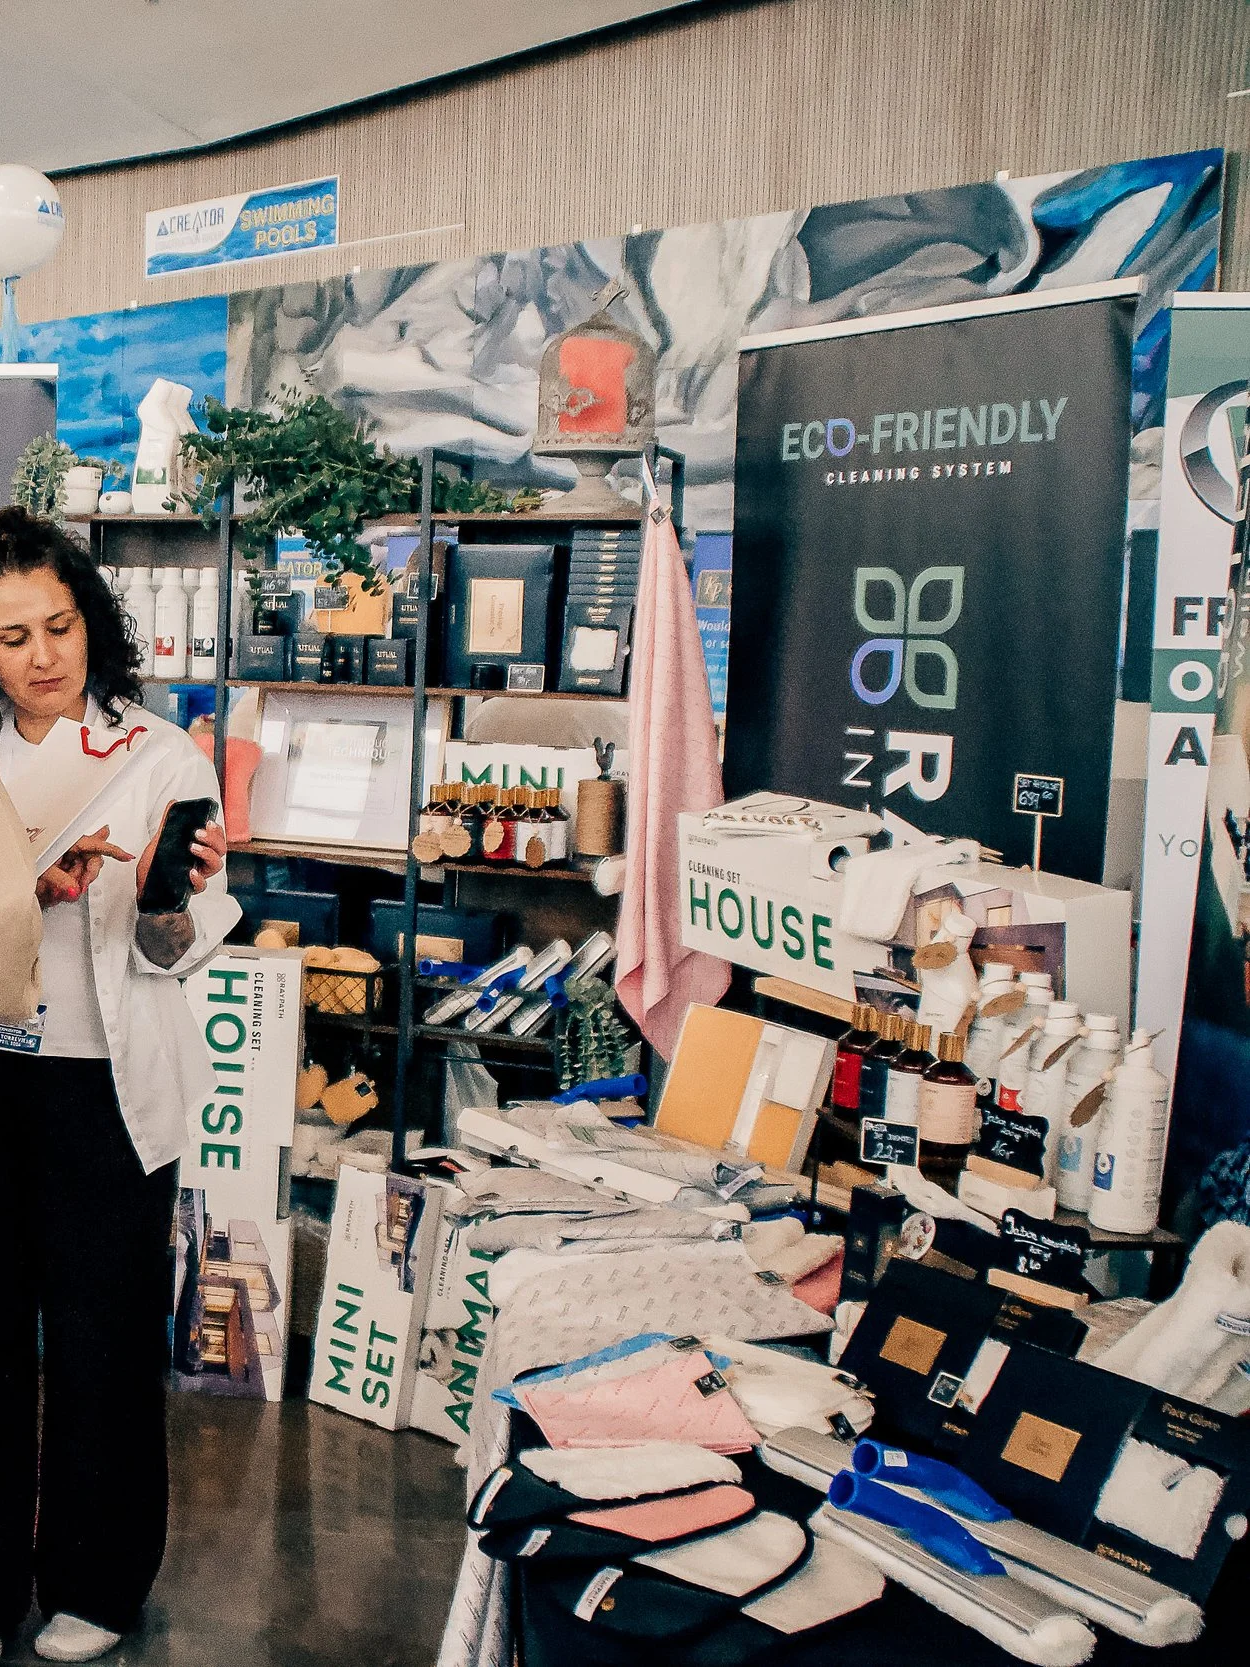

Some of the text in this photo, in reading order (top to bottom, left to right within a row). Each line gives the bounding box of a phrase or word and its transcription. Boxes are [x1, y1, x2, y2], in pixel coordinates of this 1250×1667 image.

[240, 194, 335, 231] SWIMMING
[255, 221, 317, 250] POOLS
[781, 396, 1069, 461] ECO-FRIENDLY
[825, 460, 1013, 486] CLEANING SYSTEM
[461, 762, 565, 790] MINI
[688, 860, 741, 885] CLEANING SET
[688, 877, 835, 971] HOUSE
[251, 972, 265, 1052] CLEANING SET
[278, 983, 287, 1019] RAYPATH
[437, 1255, 449, 1298] CLEANING
[325, 1283, 364, 1396] MINI
[361, 1320, 398, 1409] SET
